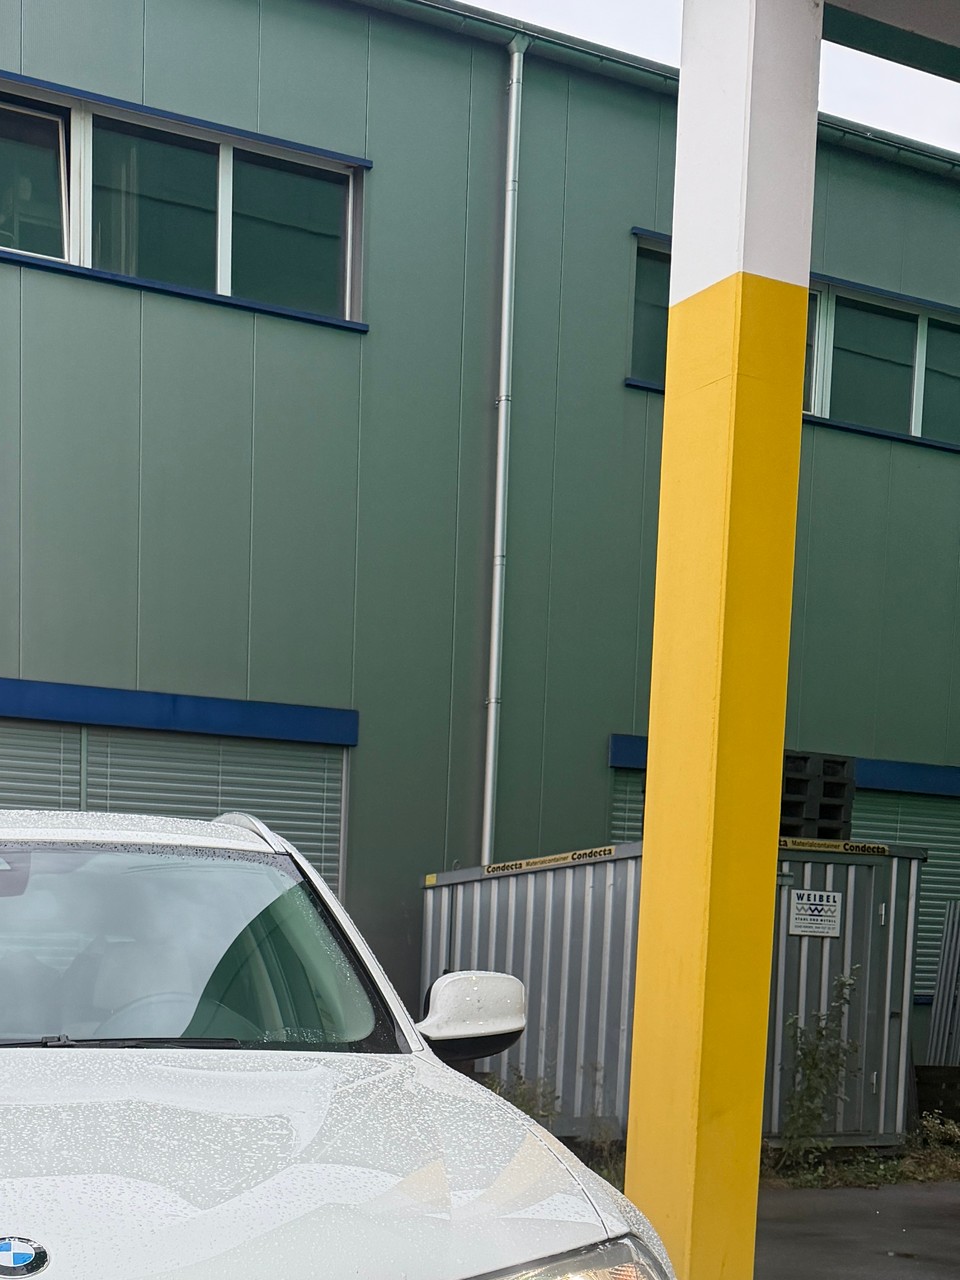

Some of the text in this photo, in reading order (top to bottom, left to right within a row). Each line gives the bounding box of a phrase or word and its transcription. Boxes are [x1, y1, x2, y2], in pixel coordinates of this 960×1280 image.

[843, 843, 886, 854] Condecta
[486, 861, 523, 874] Condecta
[571, 847, 612, 861] Condecta
[796, 892, 837, 904] WEIBEL
